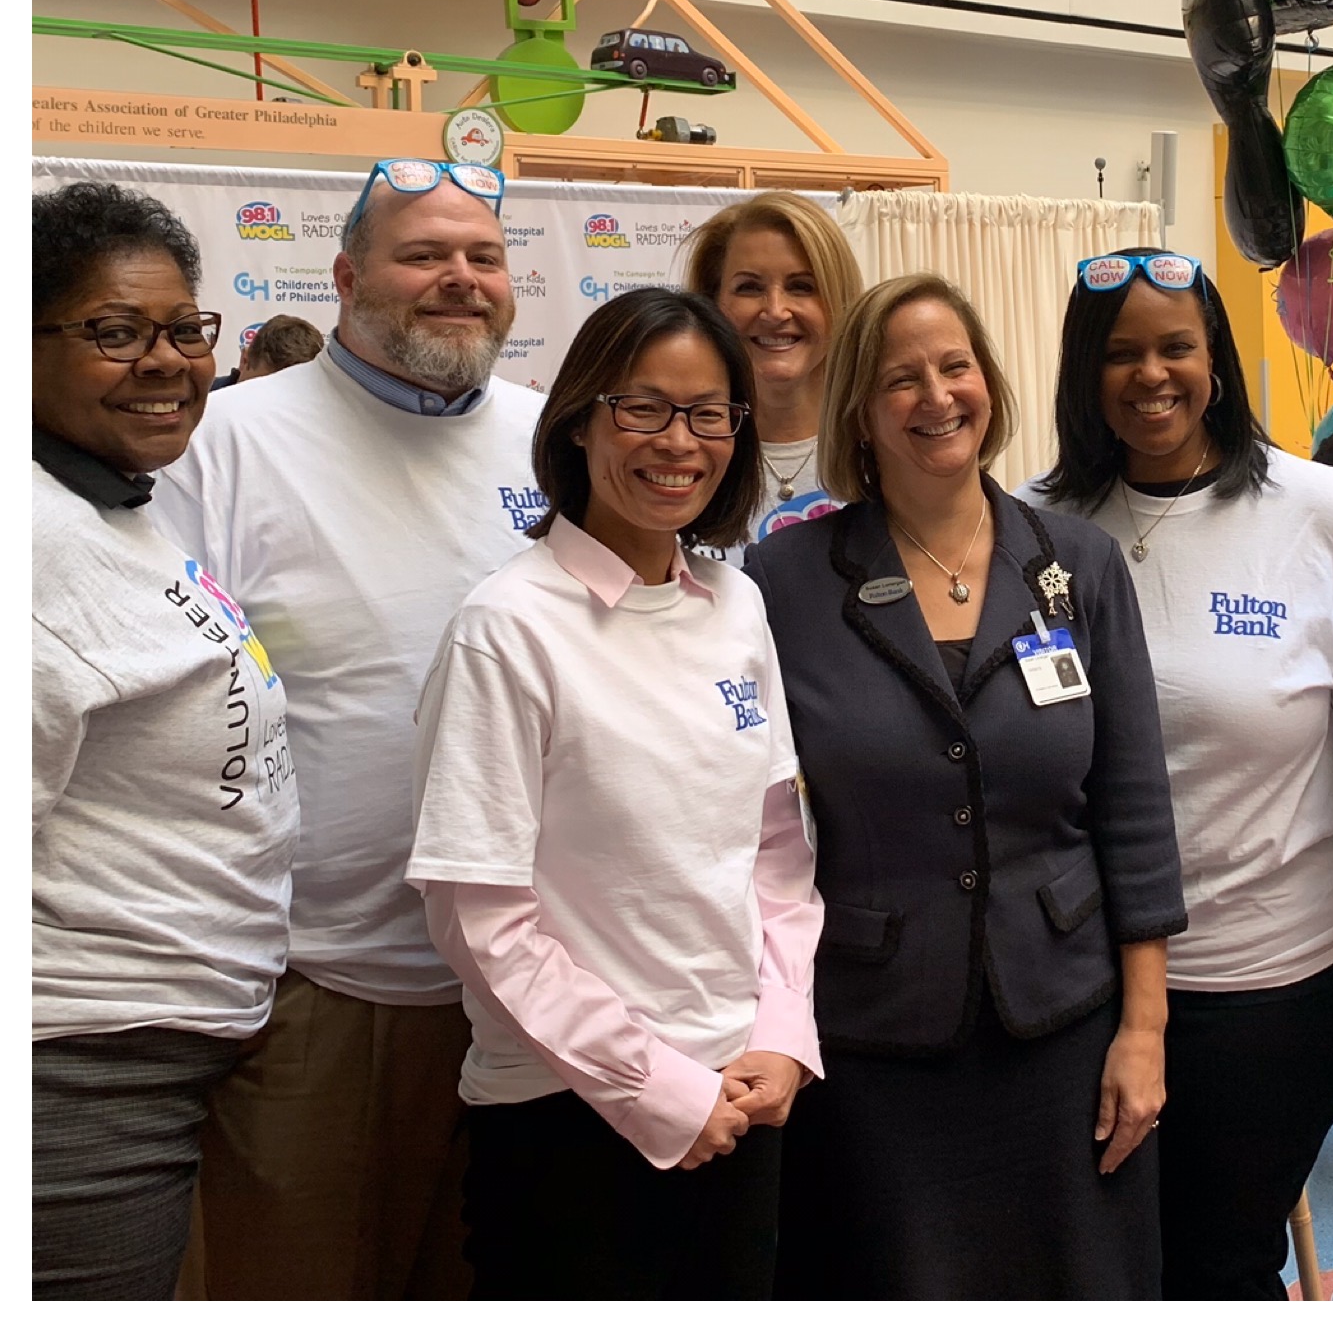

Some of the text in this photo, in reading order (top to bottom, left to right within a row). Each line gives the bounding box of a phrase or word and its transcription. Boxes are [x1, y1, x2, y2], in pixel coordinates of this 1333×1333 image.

[32, 95, 338, 129] ealers Association of Greater Philadelphia
[49, 119, 71, 133] the
[77, 121, 136, 137] children
[142, 125, 161, 137] we
[240, 205, 276, 224] 98.1
[301, 211, 347, 223] Loves Ou
[237, 224, 295, 240] WOGL
[301, 224, 344, 239] RADIO
[503, 226, 545, 238] Hospital
[587, 218, 616, 233] 98.1
[635, 222, 676, 233] Loves Our
[585, 233, 631, 248] WOGL
[274, 265, 328, 277] The Campaign
[1089, 260, 1125, 271] CALL
[526, 273, 546, 284] Kids
[1089, 272, 1125, 284] NOW
[1154, 270, 1190, 282] NOW
[275, 279, 329, 290] Children's
[275, 292, 341, 304] of Philadelp
[497, 486, 549, 509] Fult
[1208, 590, 1287, 622] Fulton
[1213, 612, 1282, 640] Bank
[164, 579, 250, 812] VOLUNTEER
